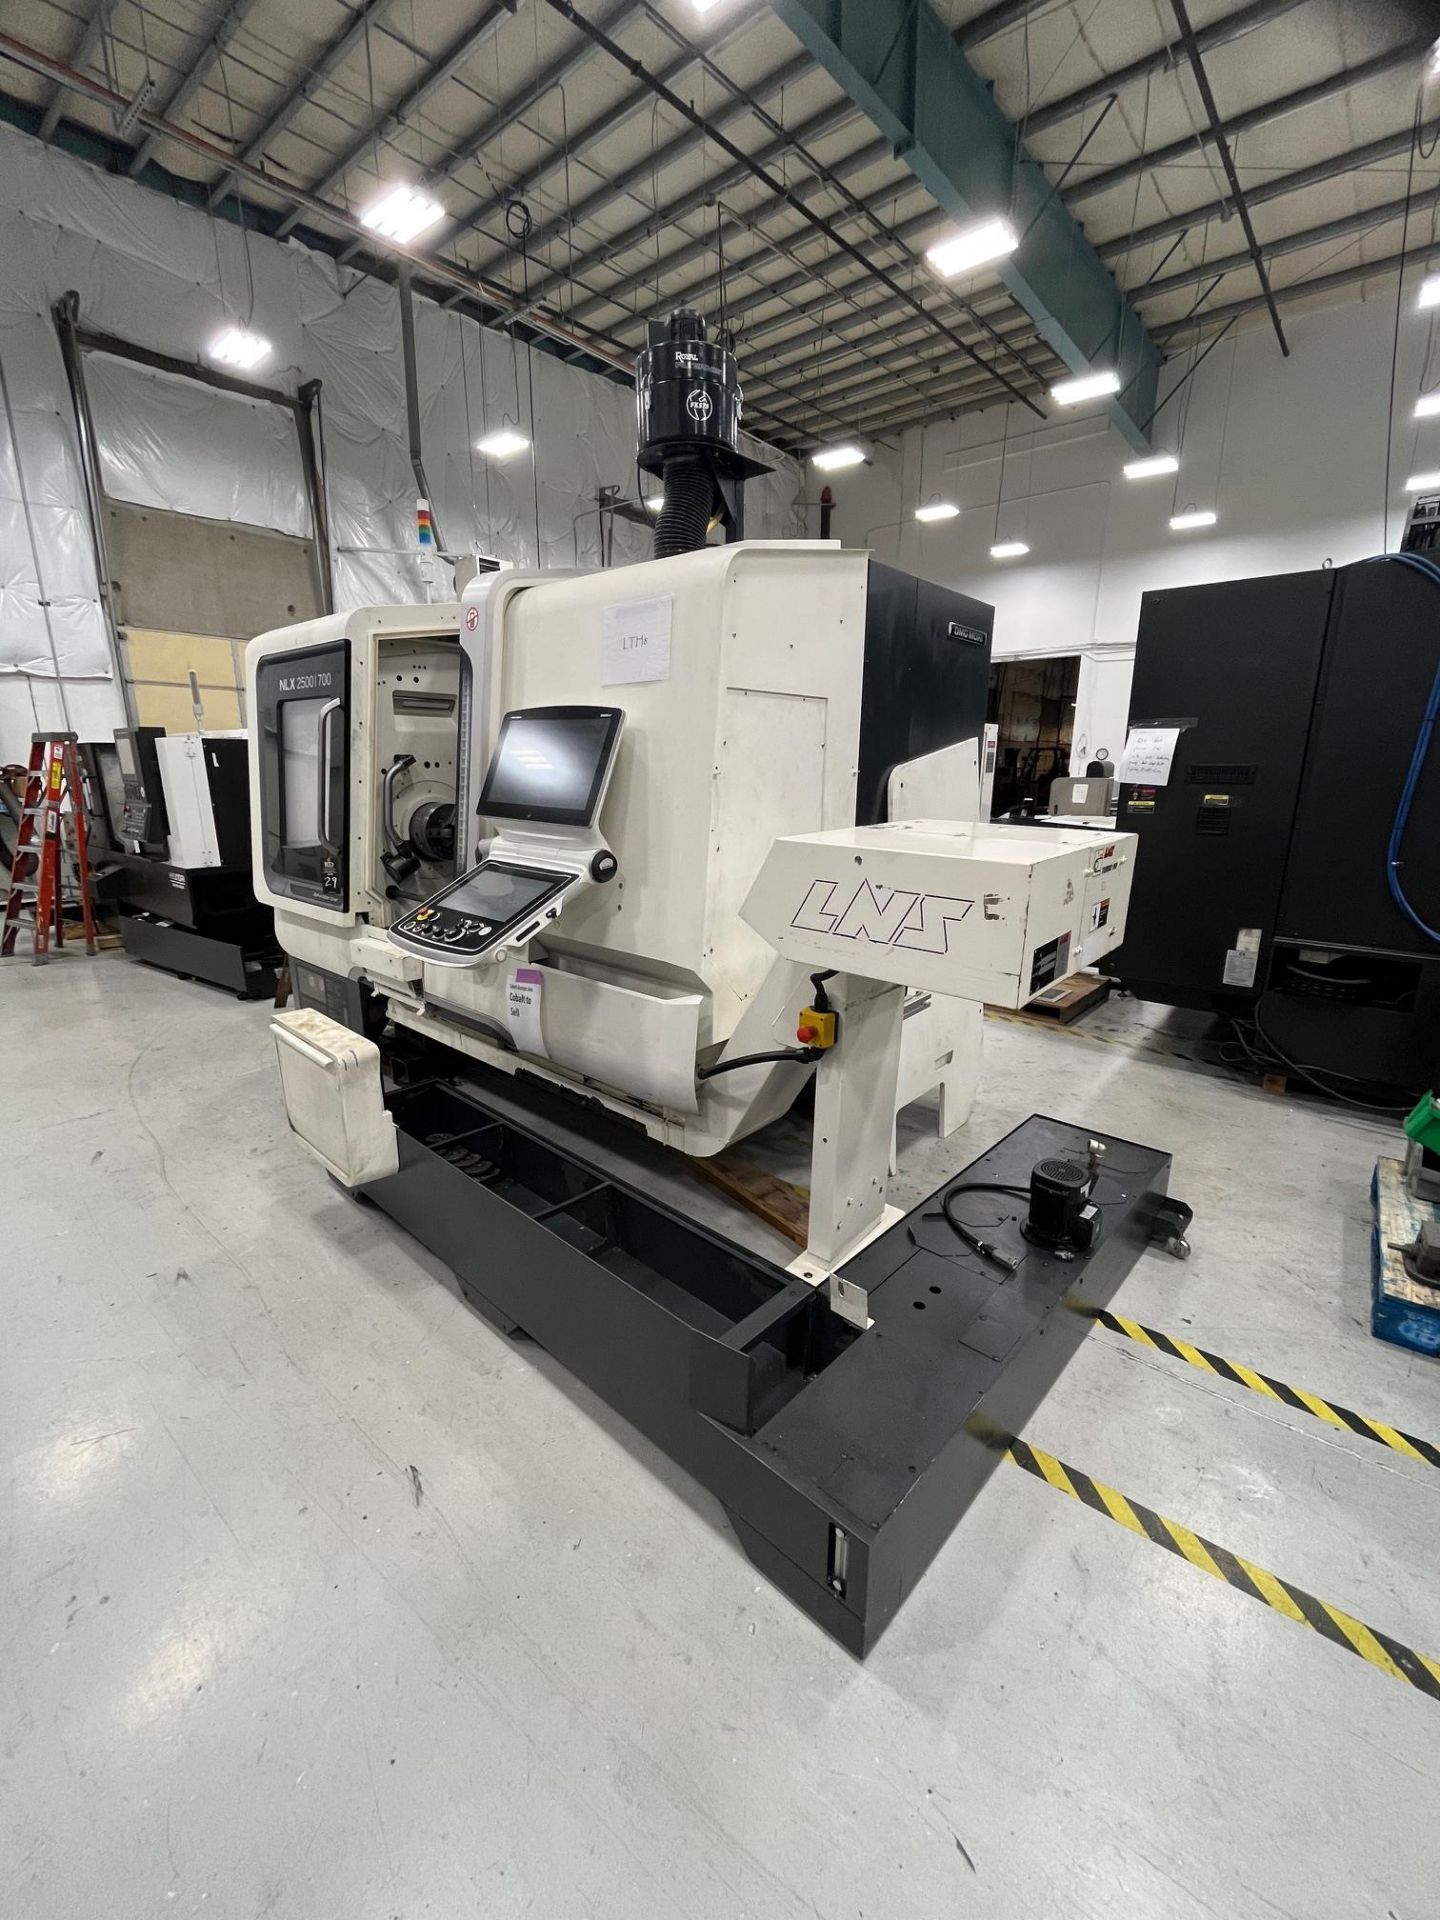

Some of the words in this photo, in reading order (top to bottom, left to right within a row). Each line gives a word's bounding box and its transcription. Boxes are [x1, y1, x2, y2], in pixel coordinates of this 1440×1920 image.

[279, 678, 295, 691] NLX
[324, 877, 337, 888] 29
[790, 877, 975, 955] LNS
[510, 992, 525, 1003] Cobalt
[510, 1007, 520, 1017] Sell
